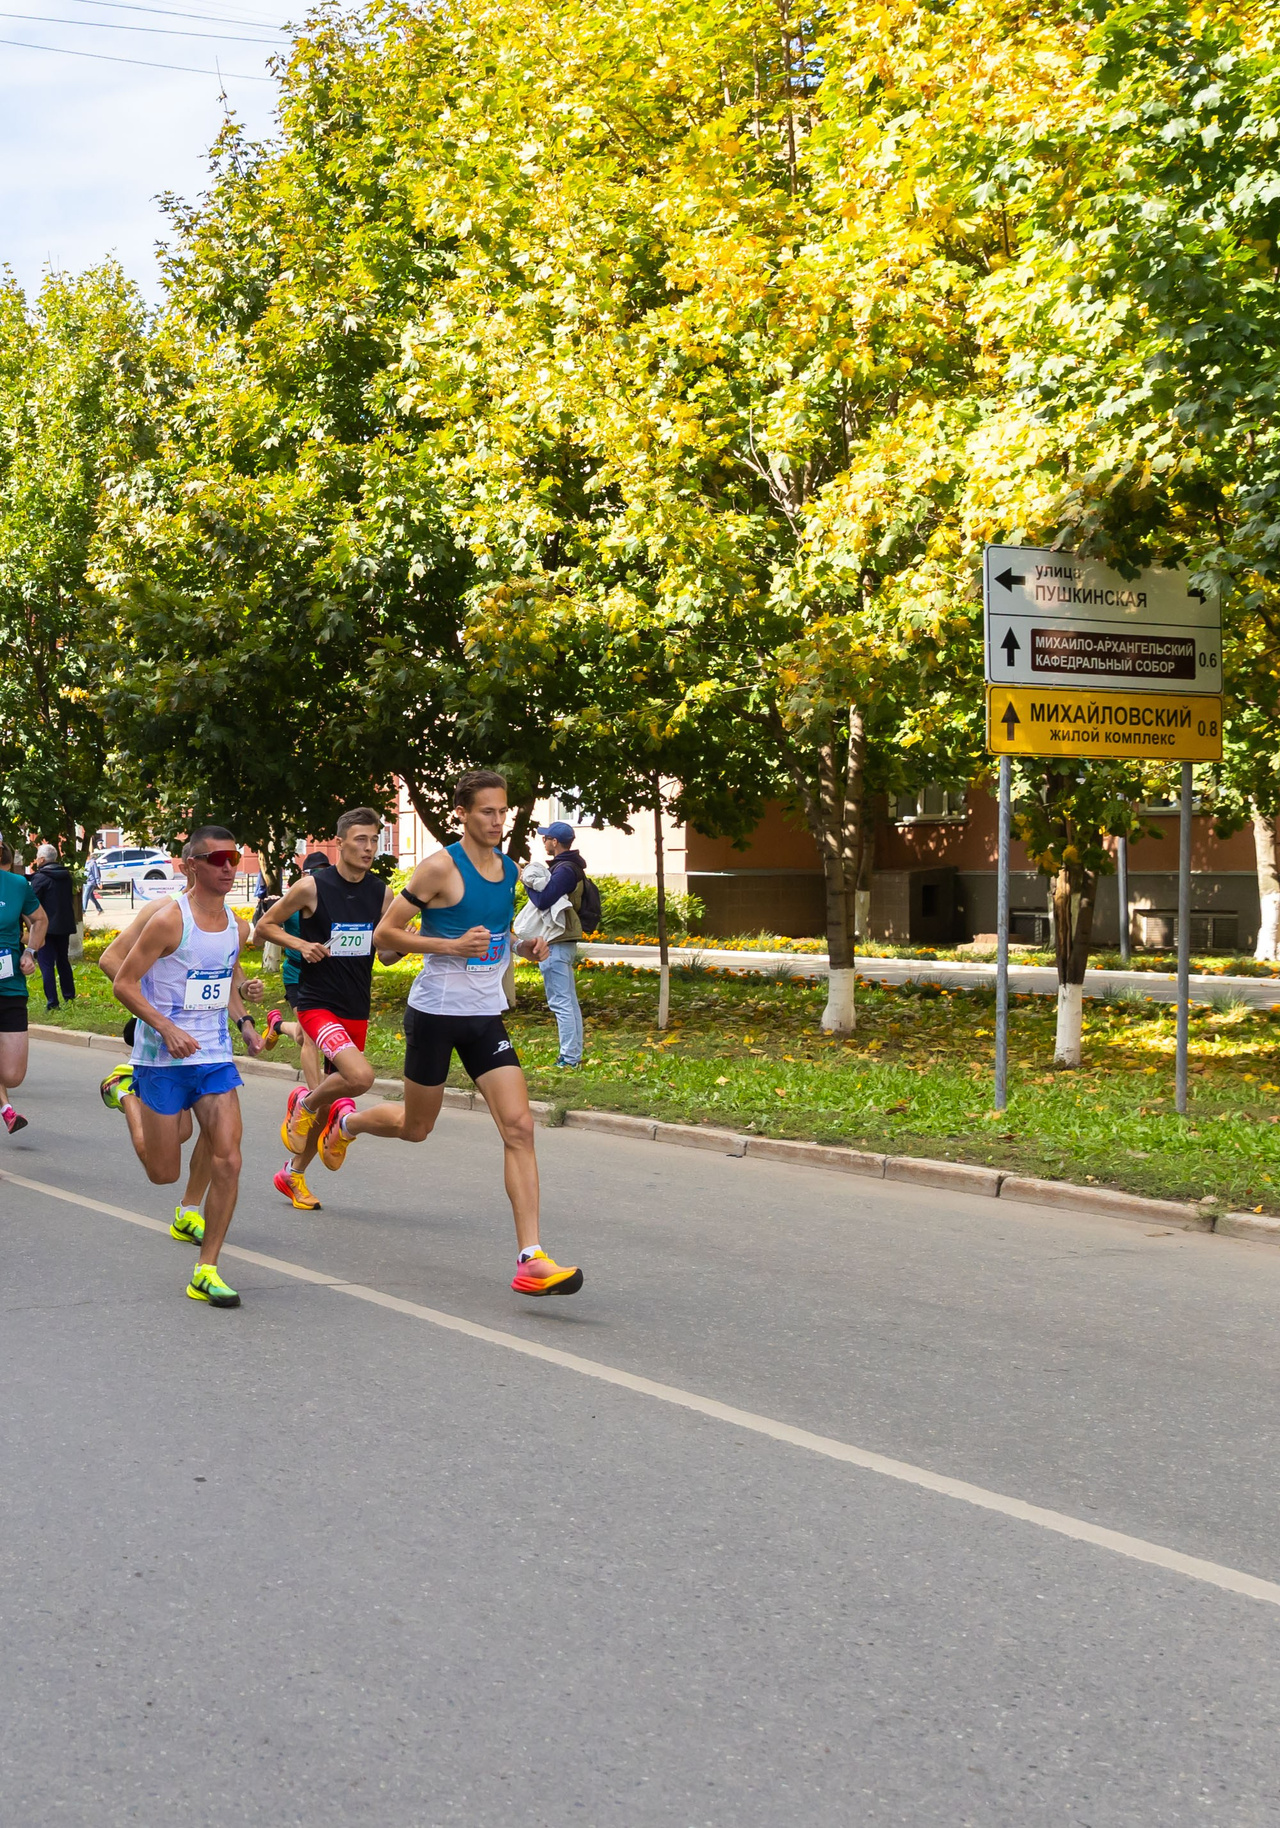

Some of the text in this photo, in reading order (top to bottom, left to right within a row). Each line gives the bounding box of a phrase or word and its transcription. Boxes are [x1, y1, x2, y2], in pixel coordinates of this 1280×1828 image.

[1035, 565, 1082, 581] улица
[1035, 585, 1147, 608] ПУШКИНСКАЯ
[1035, 654, 1175, 674] КАФЕДРАЛЬНЫЙ СОБОР
[1198, 652, 1217, 668] 0.6
[1030, 701, 1192, 728] МИХАЙЛОВСКИЙ
[1049, 727, 1176, 746] жилой комплекс
[1198, 720, 1218, 737] 0.8
[340, 935, 362, 947] 270
[201, 983, 221, 1000] 85
